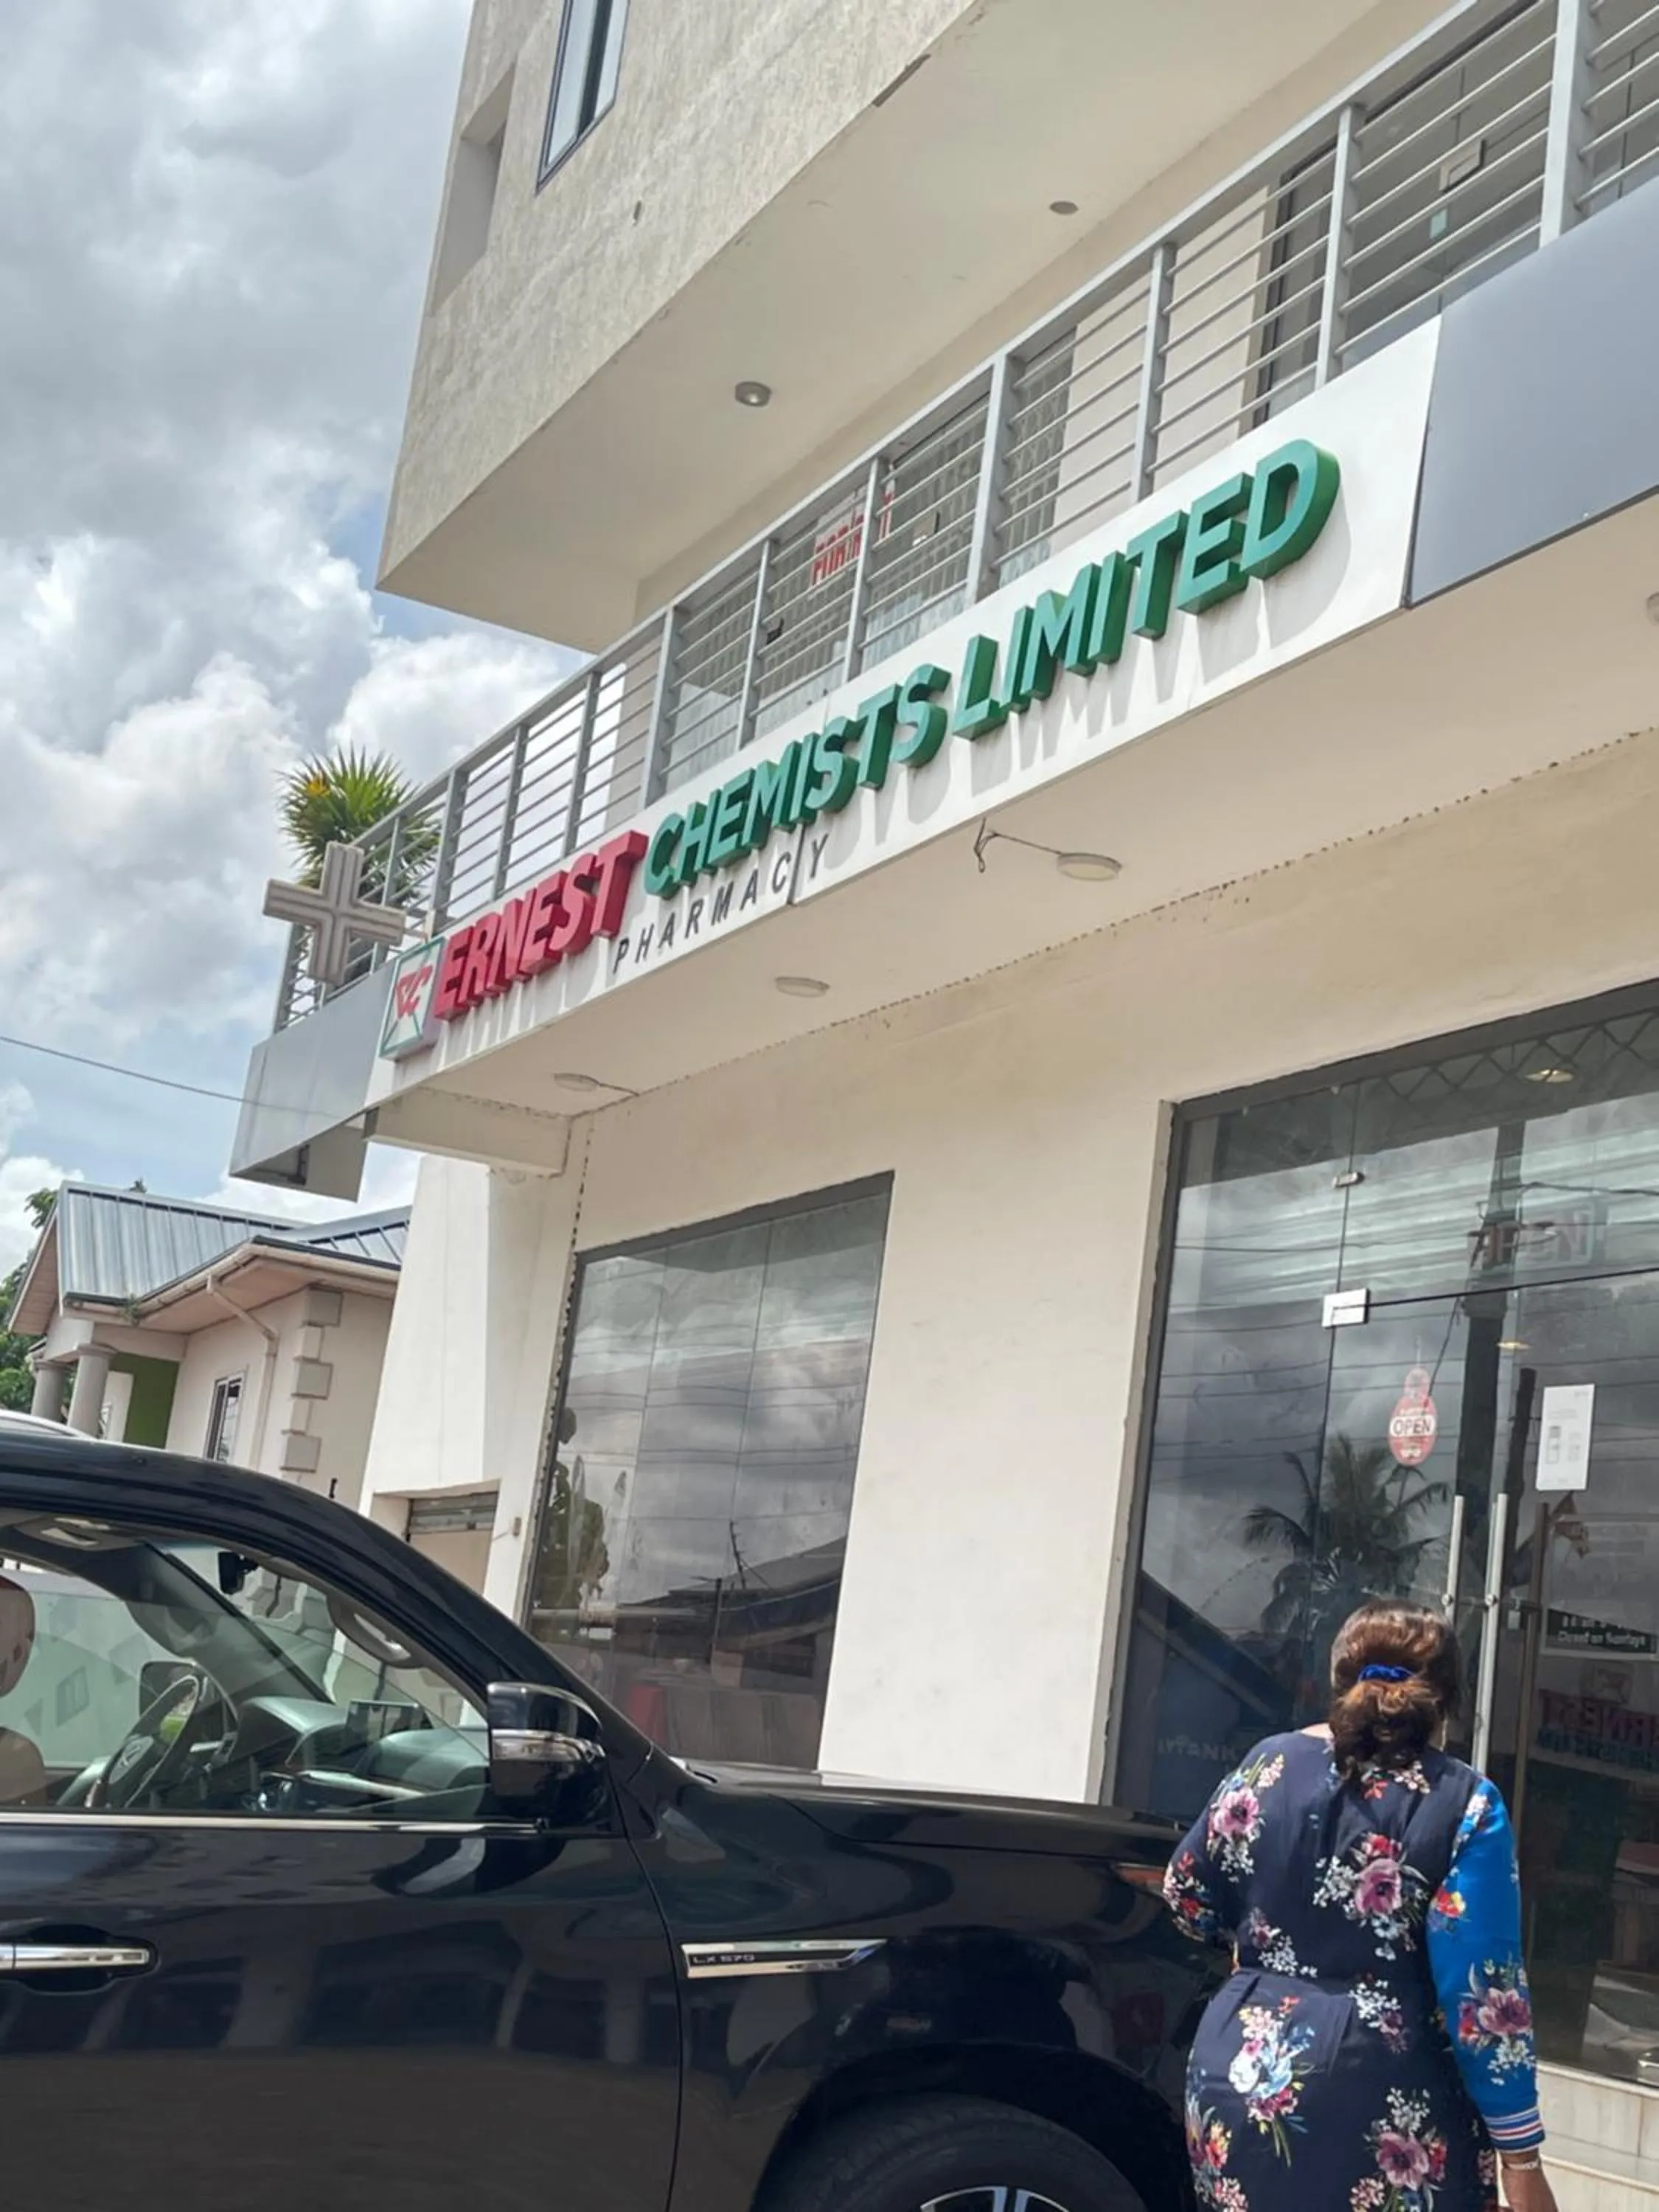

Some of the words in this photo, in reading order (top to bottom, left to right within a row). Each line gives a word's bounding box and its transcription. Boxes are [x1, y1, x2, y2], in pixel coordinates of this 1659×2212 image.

[434, 830, 650, 1021] ERNEST
[644, 664, 951, 900] CHEMISTS
[952, 439, 1340, 741] LIMITED
[612, 834, 829, 975] PHARMACY
[1393, 1417, 1432, 1436] OPEN
[692, 1955, 717, 1964] LX
[720, 1954, 756, 1963] 570
